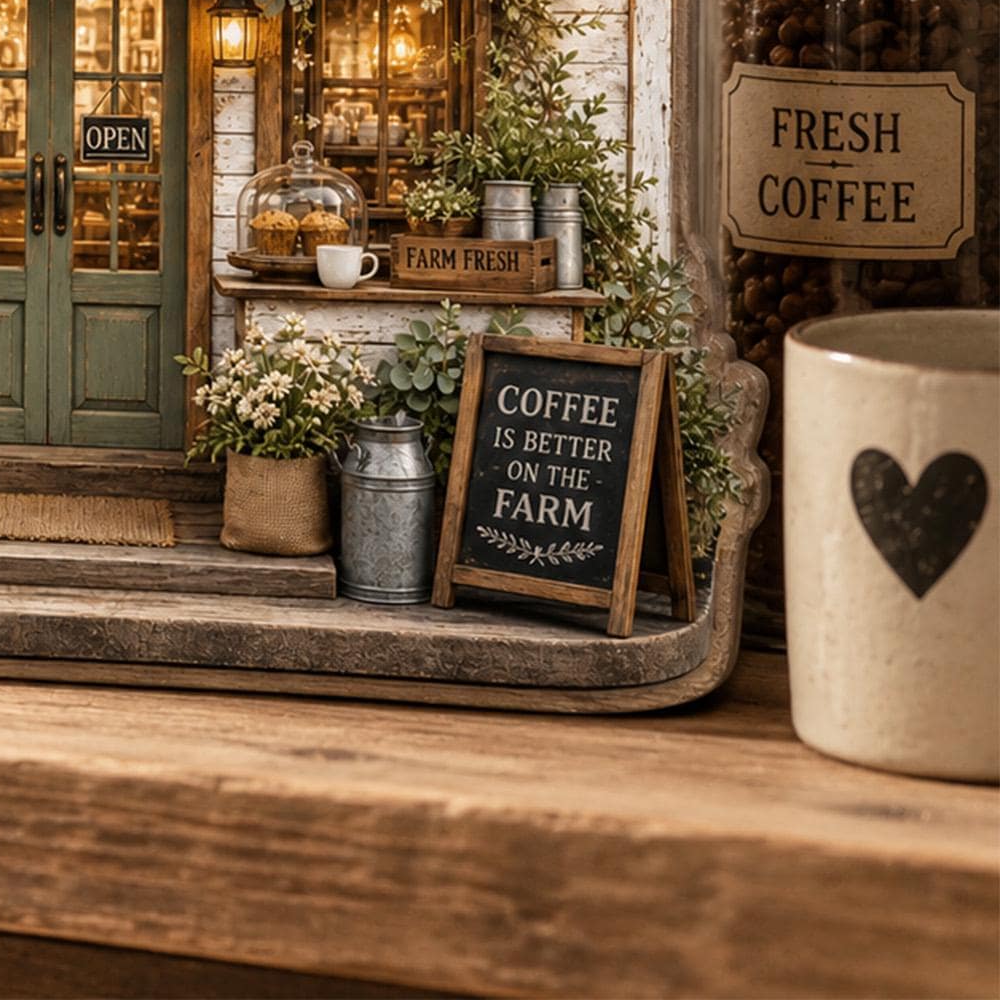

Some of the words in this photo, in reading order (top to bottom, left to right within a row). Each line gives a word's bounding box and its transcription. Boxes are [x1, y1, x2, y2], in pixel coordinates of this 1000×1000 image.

[86, 125, 147, 151] OPEN
[771, 106, 901, 153] FRESH
[758, 173, 916, 223] COFFEE
[406, 247, 456, 270] FARM
[463, 249, 520, 273] FRESH
[497, 384, 620, 428] COFFEE
[493, 426, 516, 450] IS
[523, 430, 613, 463] BETTER
[507, 459, 540, 483] ON
[547, 464, 592, 491] THE
[493, 488, 594, 532] FARM
